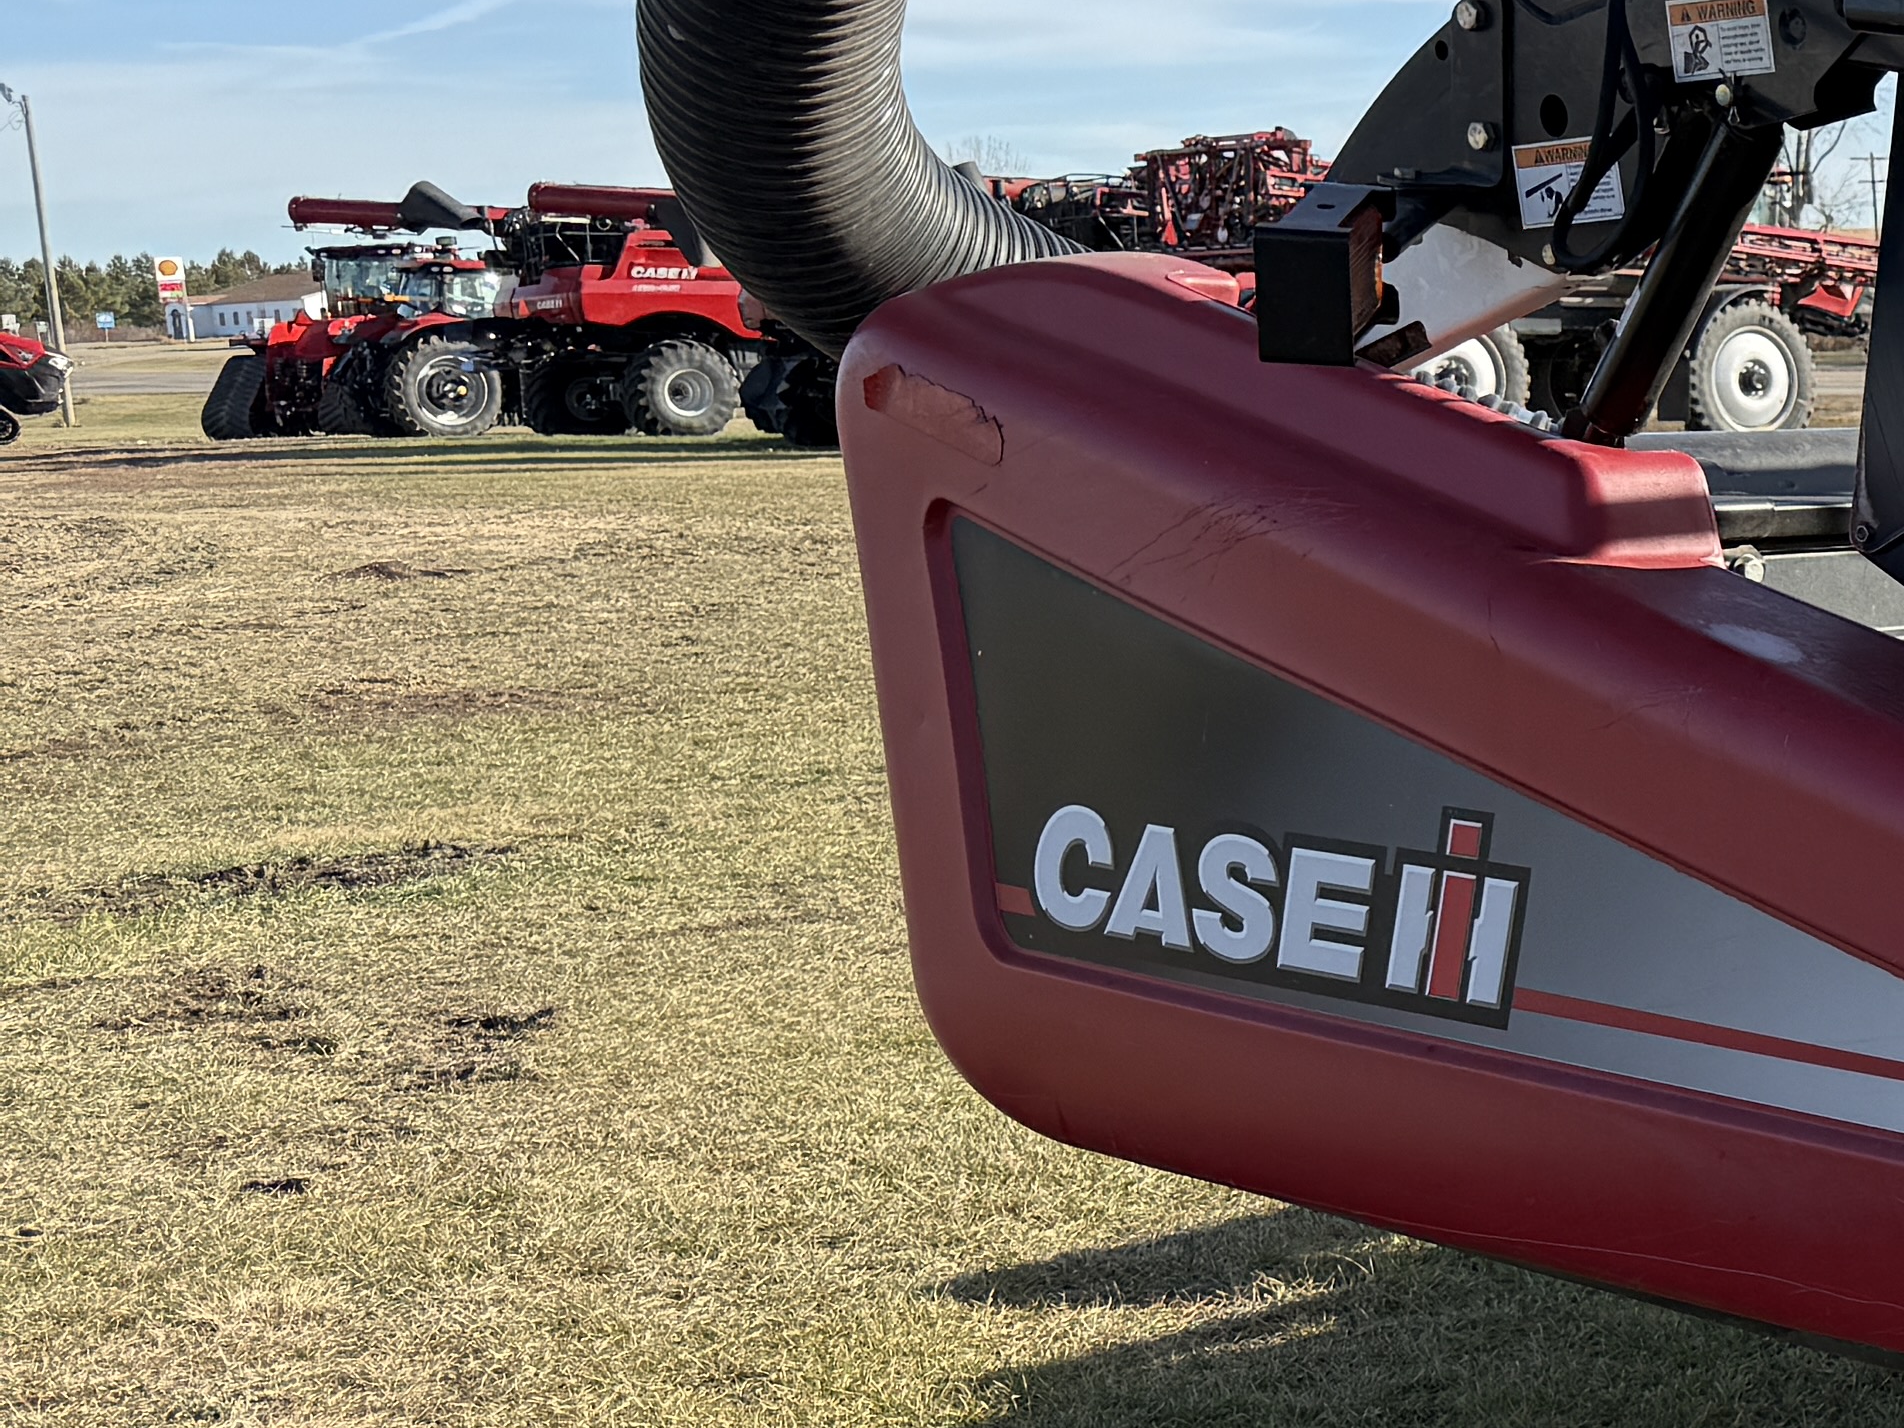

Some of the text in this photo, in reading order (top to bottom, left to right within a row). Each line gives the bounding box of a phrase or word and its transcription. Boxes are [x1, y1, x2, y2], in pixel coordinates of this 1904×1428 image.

[1696, 0, 1756, 21] WARNING
[1544, 145, 1588, 163] WARNIN
[1034, 804, 1376, 984] CASE
